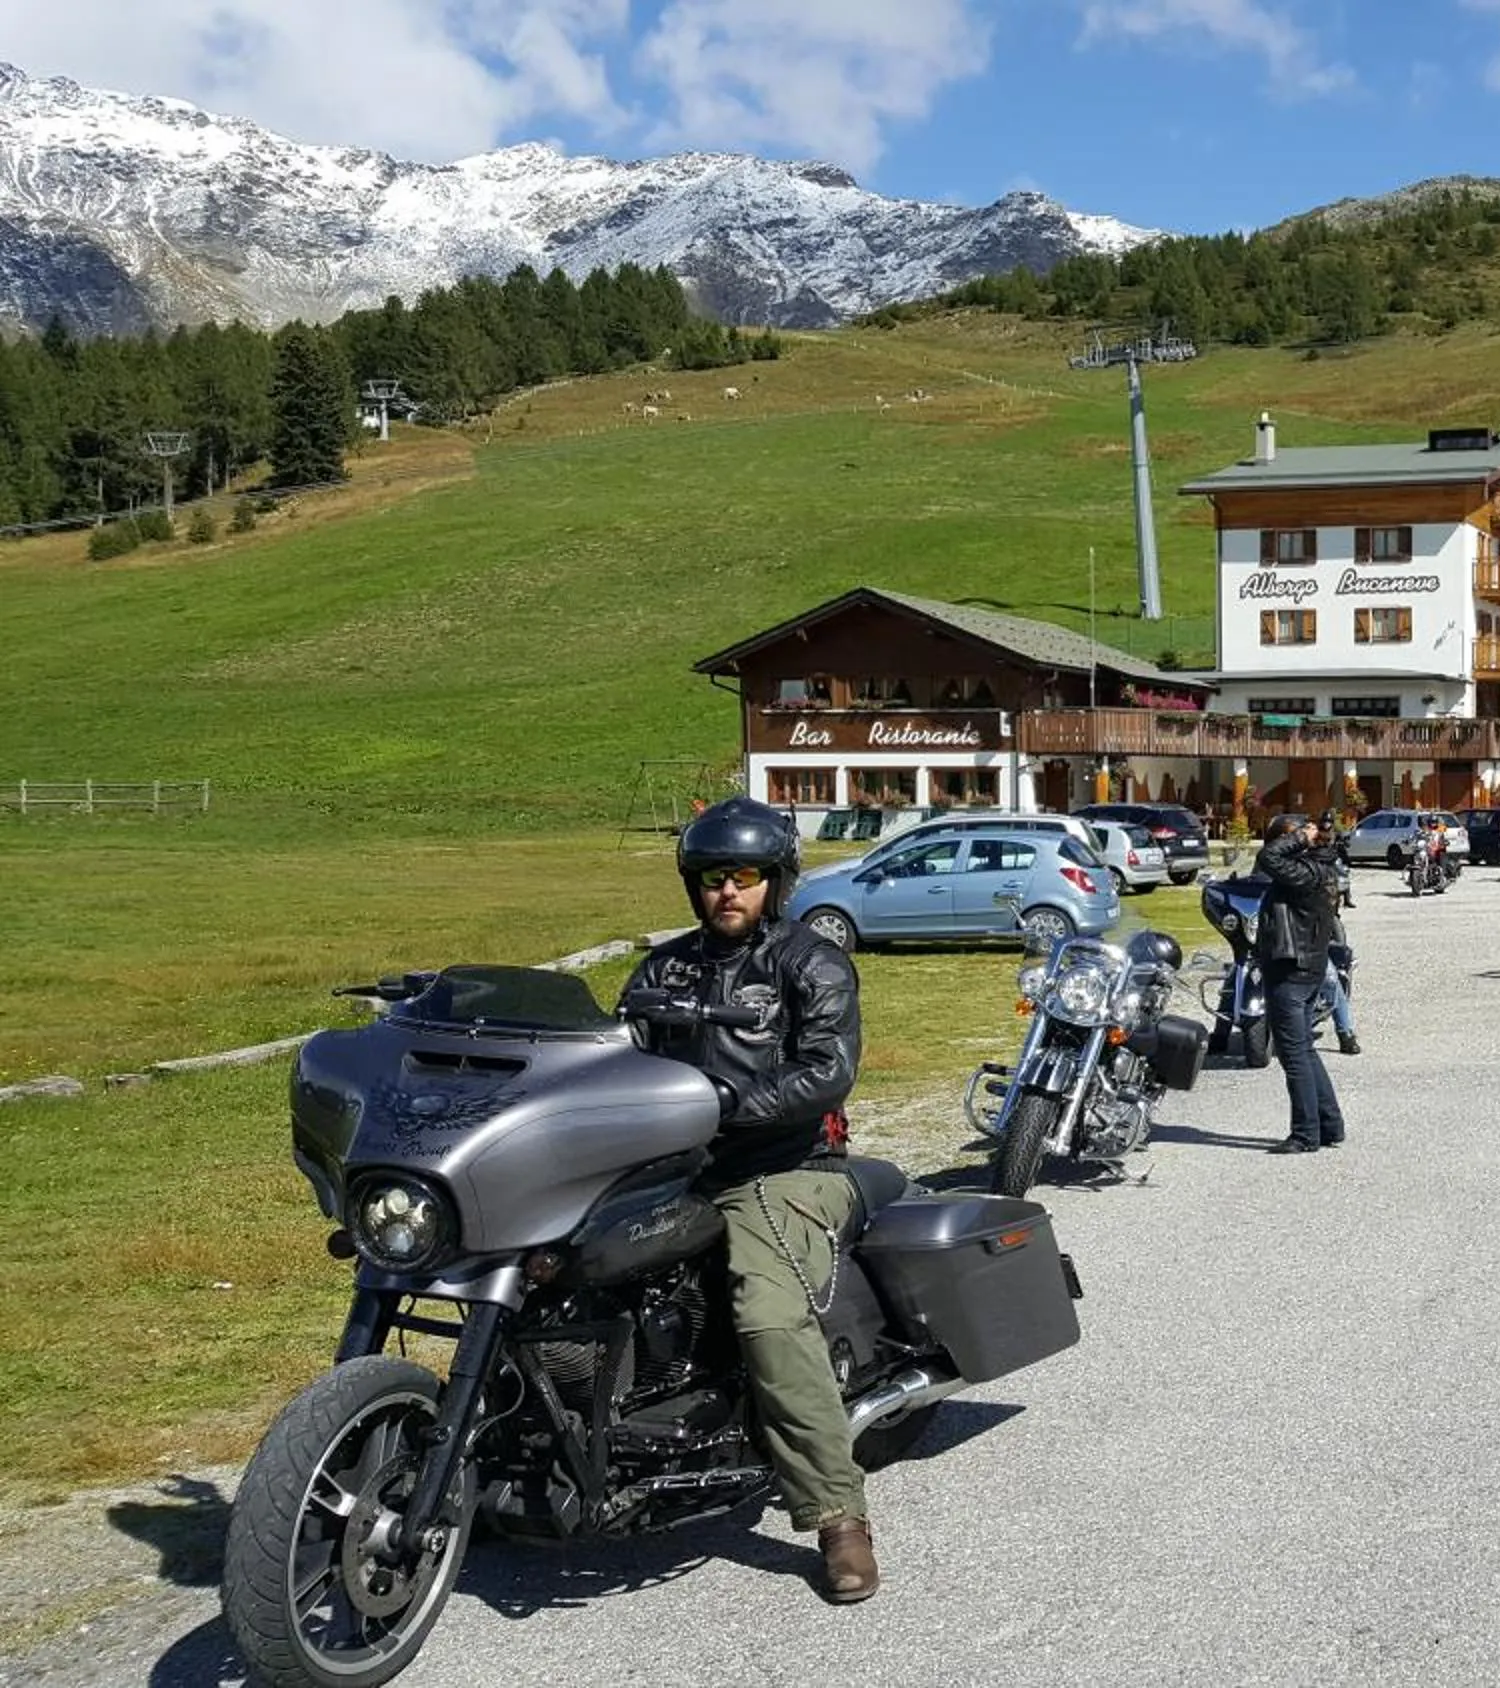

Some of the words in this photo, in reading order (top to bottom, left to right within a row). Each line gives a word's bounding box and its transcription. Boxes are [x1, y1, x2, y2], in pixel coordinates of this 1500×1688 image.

[1239, 571, 1319, 604] Albergo
[1335, 568, 1440, 595] Bucaneve
[788, 721, 833, 746] Bar
[867, 721, 981, 746] Ristorante
